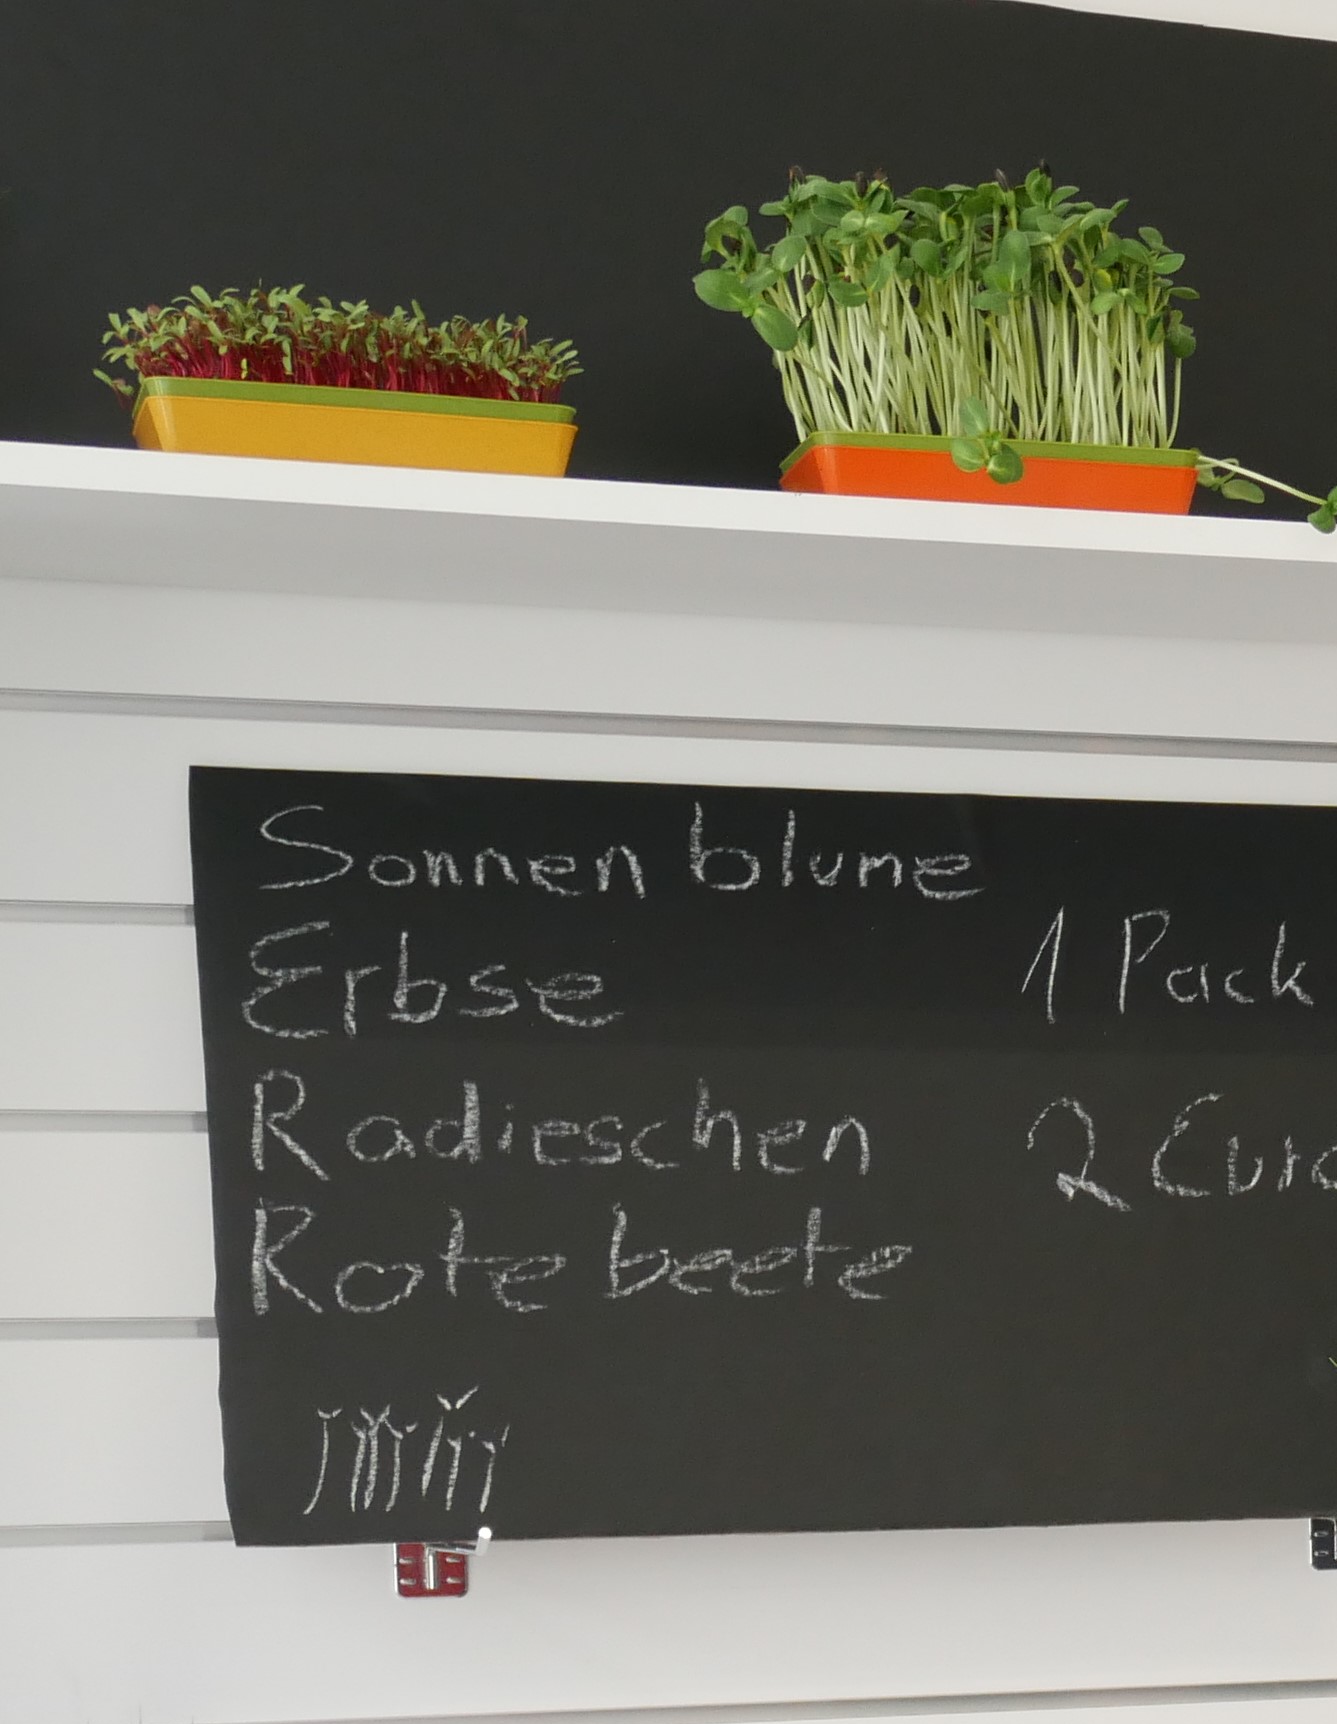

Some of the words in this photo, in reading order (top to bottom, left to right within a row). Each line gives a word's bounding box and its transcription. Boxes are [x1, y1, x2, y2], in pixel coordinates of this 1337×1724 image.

[242, 921, 624, 1040] Erbse
[1021, 905, 1064, 1025] 1
[1118, 909, 1315, 1015] Pack
[250, 1069, 872, 1182] Radieschen
[1026, 1097, 1131, 1212] 2
